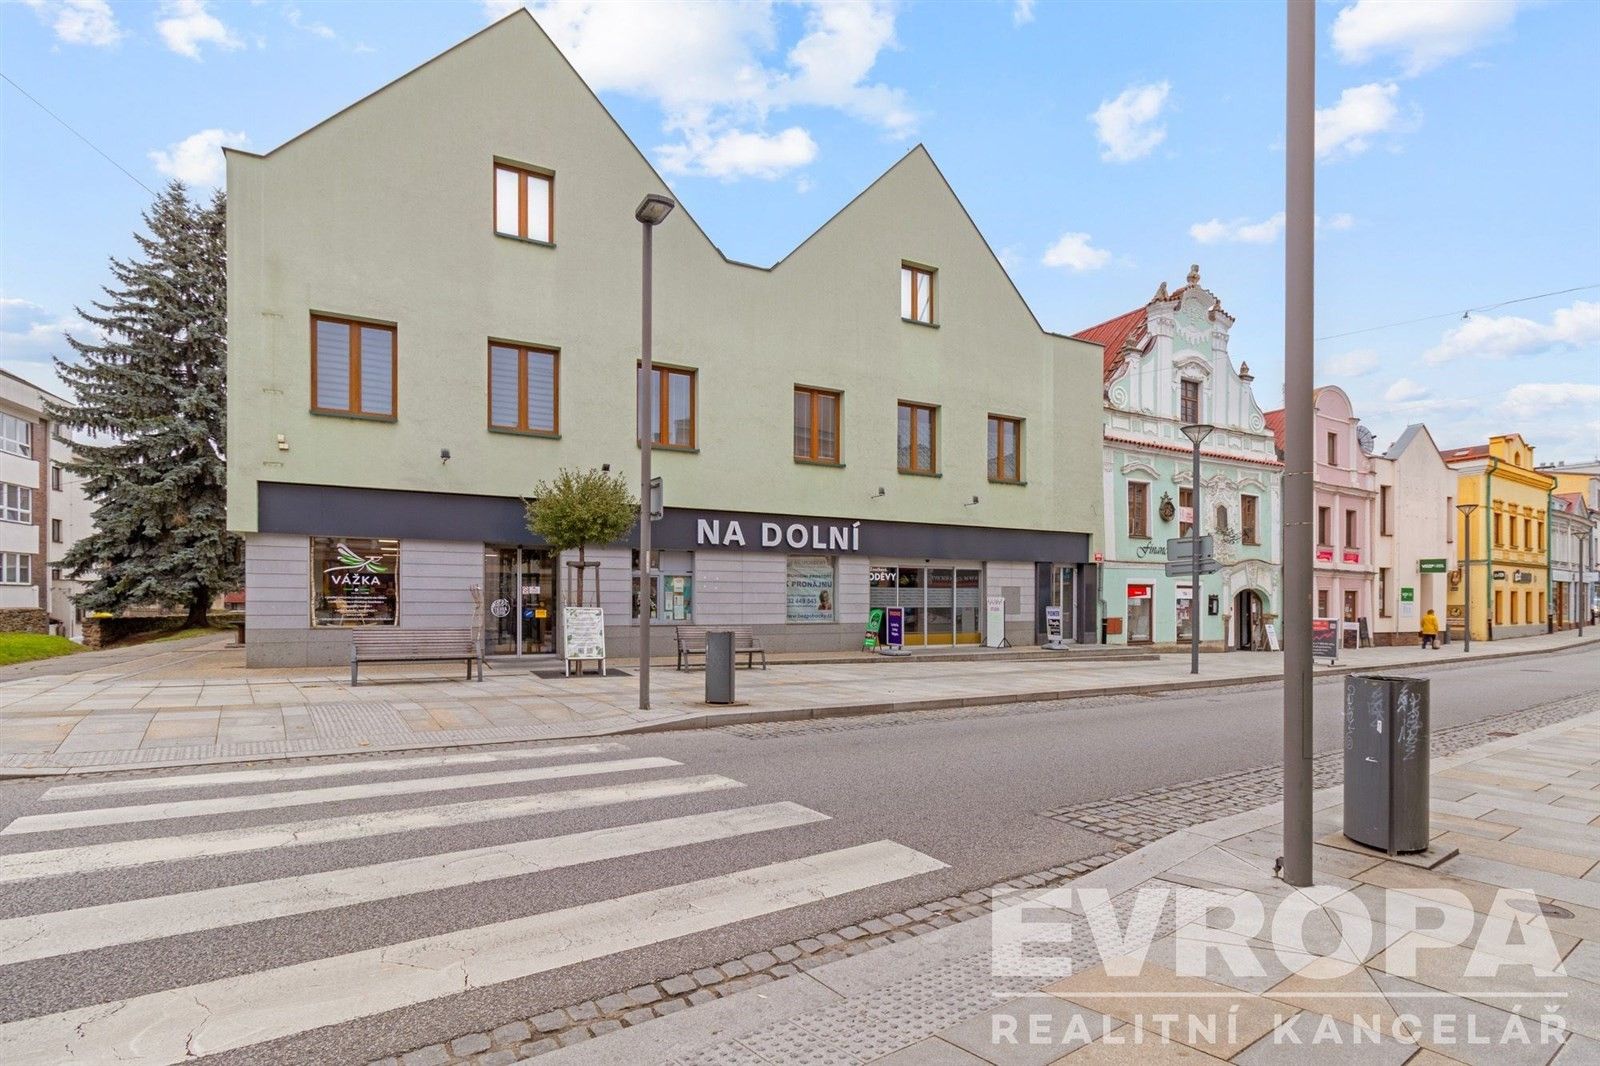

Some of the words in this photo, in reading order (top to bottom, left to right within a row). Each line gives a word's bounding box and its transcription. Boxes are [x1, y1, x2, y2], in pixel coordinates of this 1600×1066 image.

[697, 518, 746, 547] NA
[761, 521, 861, 551] DOLNÍ
[331, 572, 381, 586] VÁŽKA
